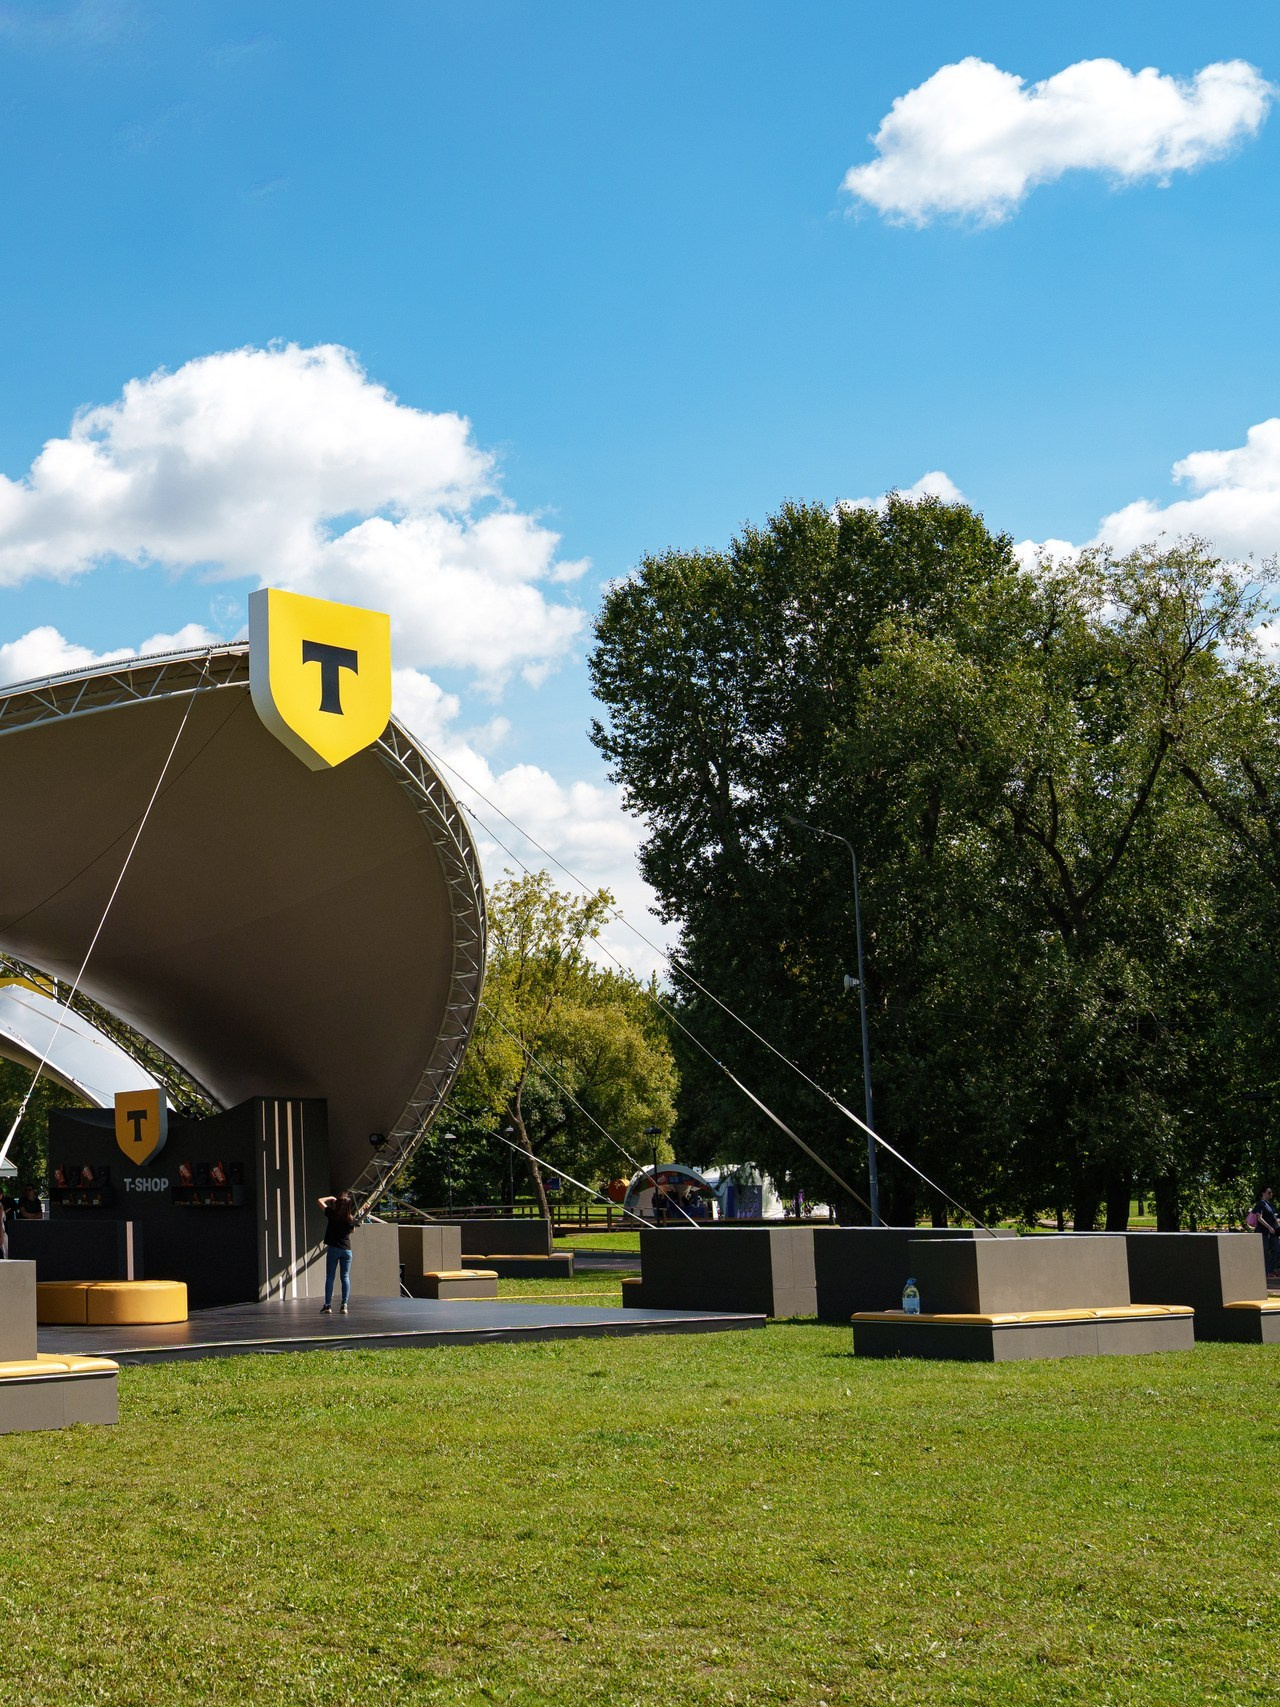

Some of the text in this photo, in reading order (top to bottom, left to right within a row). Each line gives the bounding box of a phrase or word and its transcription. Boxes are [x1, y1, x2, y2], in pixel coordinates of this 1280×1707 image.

[302, 639, 358, 715] T
[126, 1109, 147, 1142] T
[123, 1177, 169, 1192] T-SHOP
